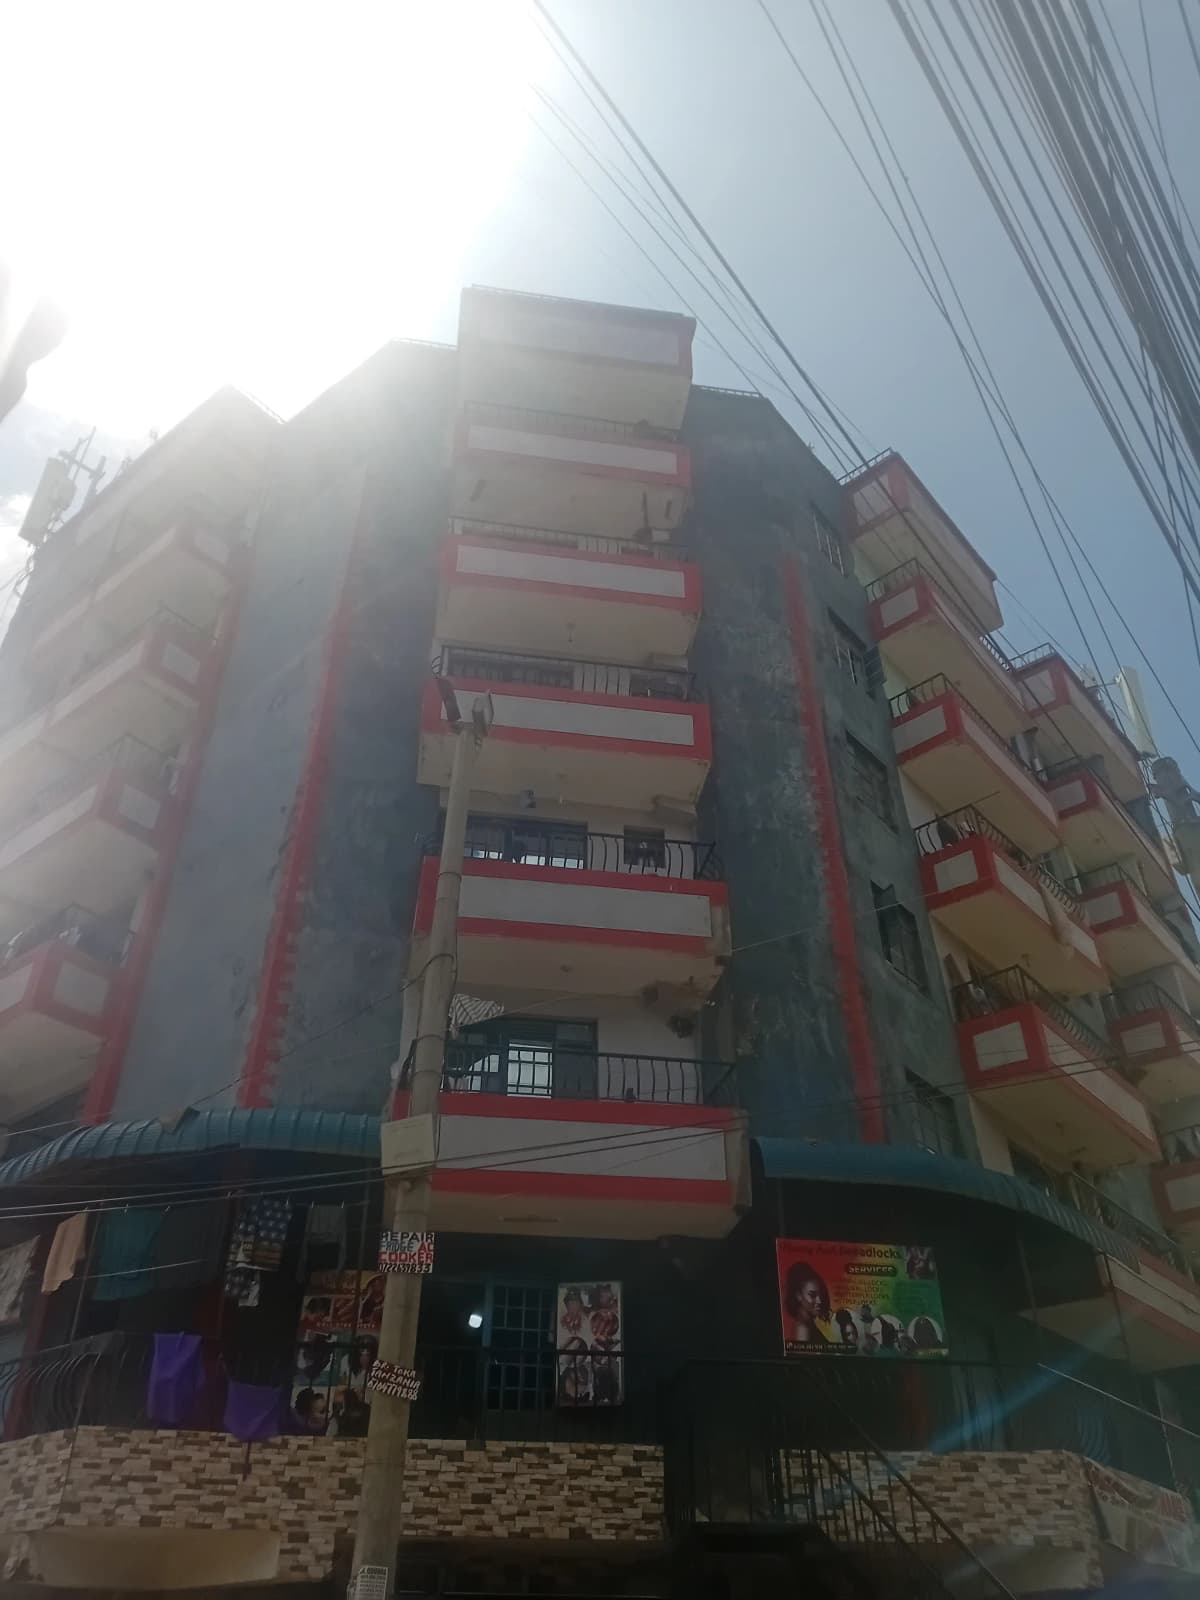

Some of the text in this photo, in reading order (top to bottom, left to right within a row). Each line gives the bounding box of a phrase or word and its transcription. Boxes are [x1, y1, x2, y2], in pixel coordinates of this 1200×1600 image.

[380, 1232, 434, 1242] REPAIR
[418, 1241, 434, 1252] AC
[379, 1251, 434, 1263] COOKER
[371, 1367, 420, 1390] TANZANIA
